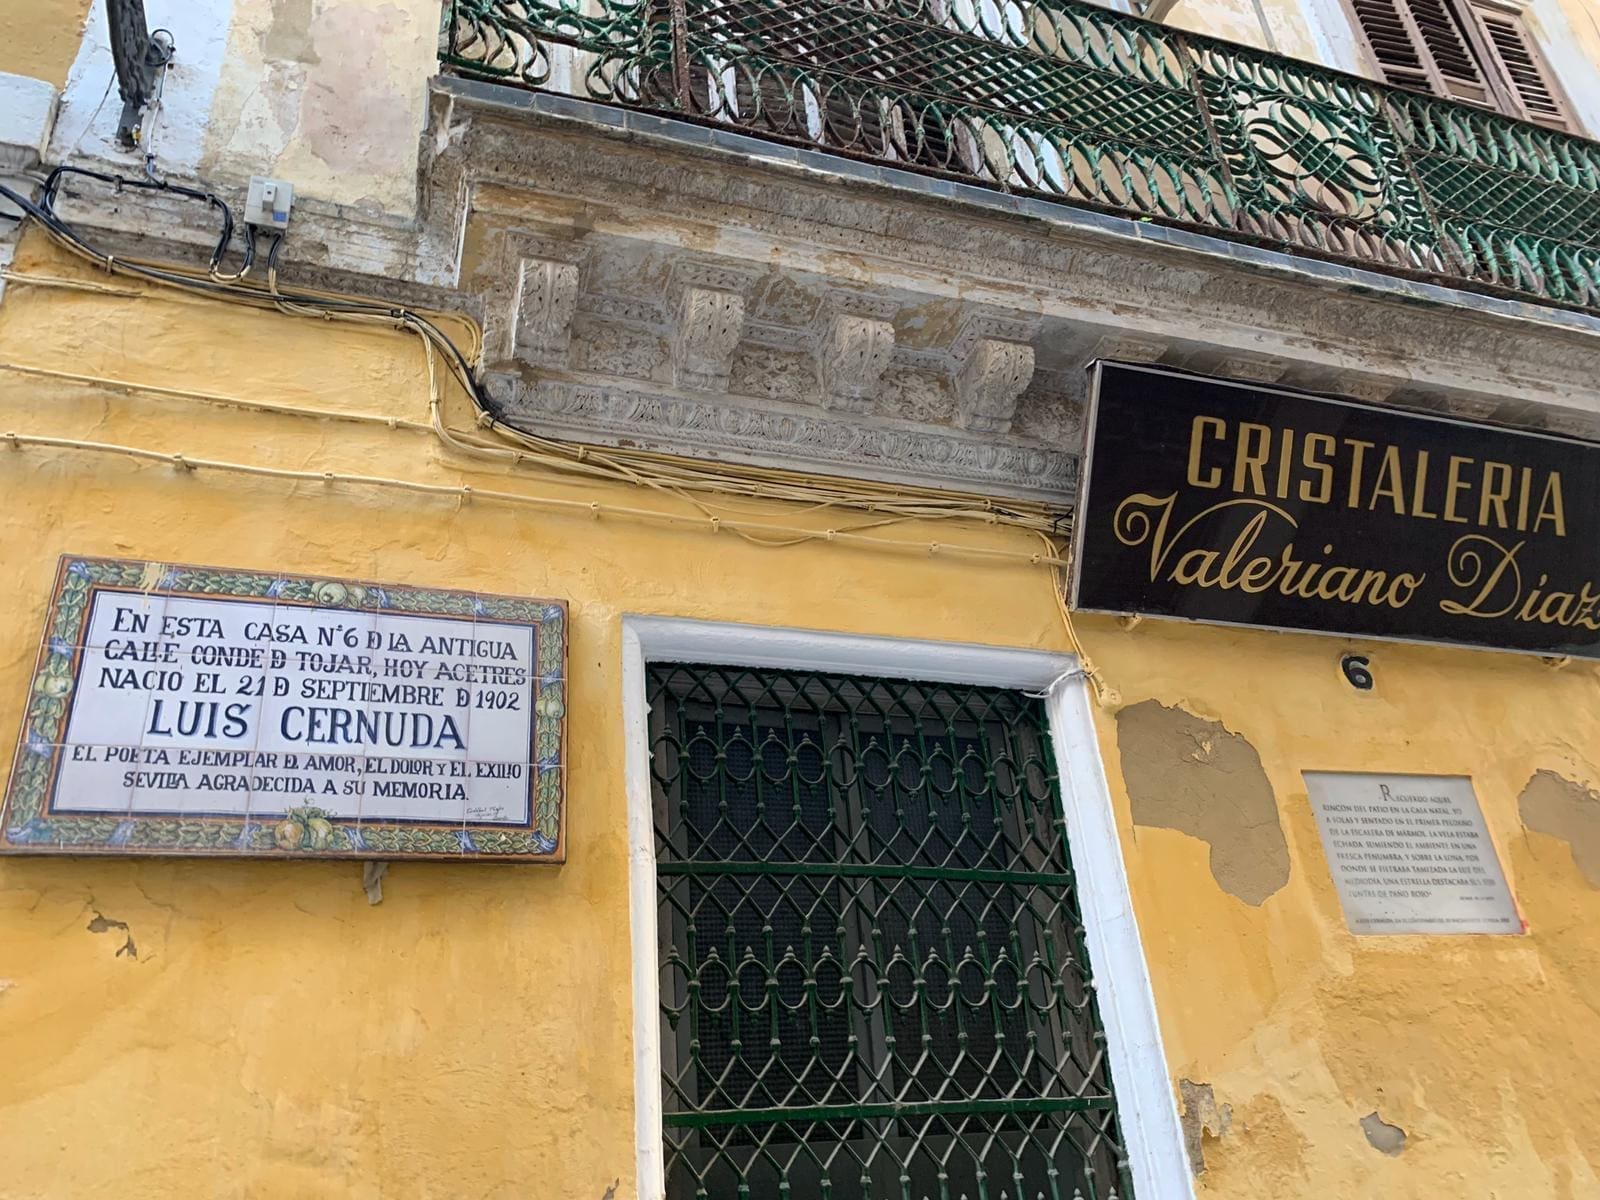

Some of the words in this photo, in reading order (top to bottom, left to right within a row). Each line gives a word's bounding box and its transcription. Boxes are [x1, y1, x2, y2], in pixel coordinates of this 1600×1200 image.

[1187, 415, 1566, 536] CRISTALERIA
[1113, 490, 1426, 609] Valeriano
[111, 607, 151, 633] EN
[158, 616, 225, 640] ESTA
[244, 622, 309, 645] CASA
[419, 636, 518, 661] ANTIGUA
[104, 639, 180, 663] CALLE
[191, 645, 265, 669] CONDE
[295, 651, 378, 678] TOJAR,
[383, 658, 429, 679] HOY
[434, 662, 527, 686] ACETRES
[1341, 655, 1374, 690] 6
[192, 673, 226, 694] EL
[236, 675, 265, 697] 21
[301, 678, 444, 707] SEPTIEMBRE
[475, 690, 521, 711] 1902
[147, 699, 252, 738] LUIS
[280, 705, 467, 750] CERNUDA
[72, 746, 97, 762] EL
[104, 748, 170, 765] POETA
[178, 751, 278, 770] EJEMPLAR
[303, 755, 362, 776] AMOR,
[364, 757, 388, 774] EL
[122, 771, 191, 790] SEVILLA
[196, 774, 317, 794] AGRADECIDA
[321, 778, 338, 795] A
[343, 780, 366, 795] SU
